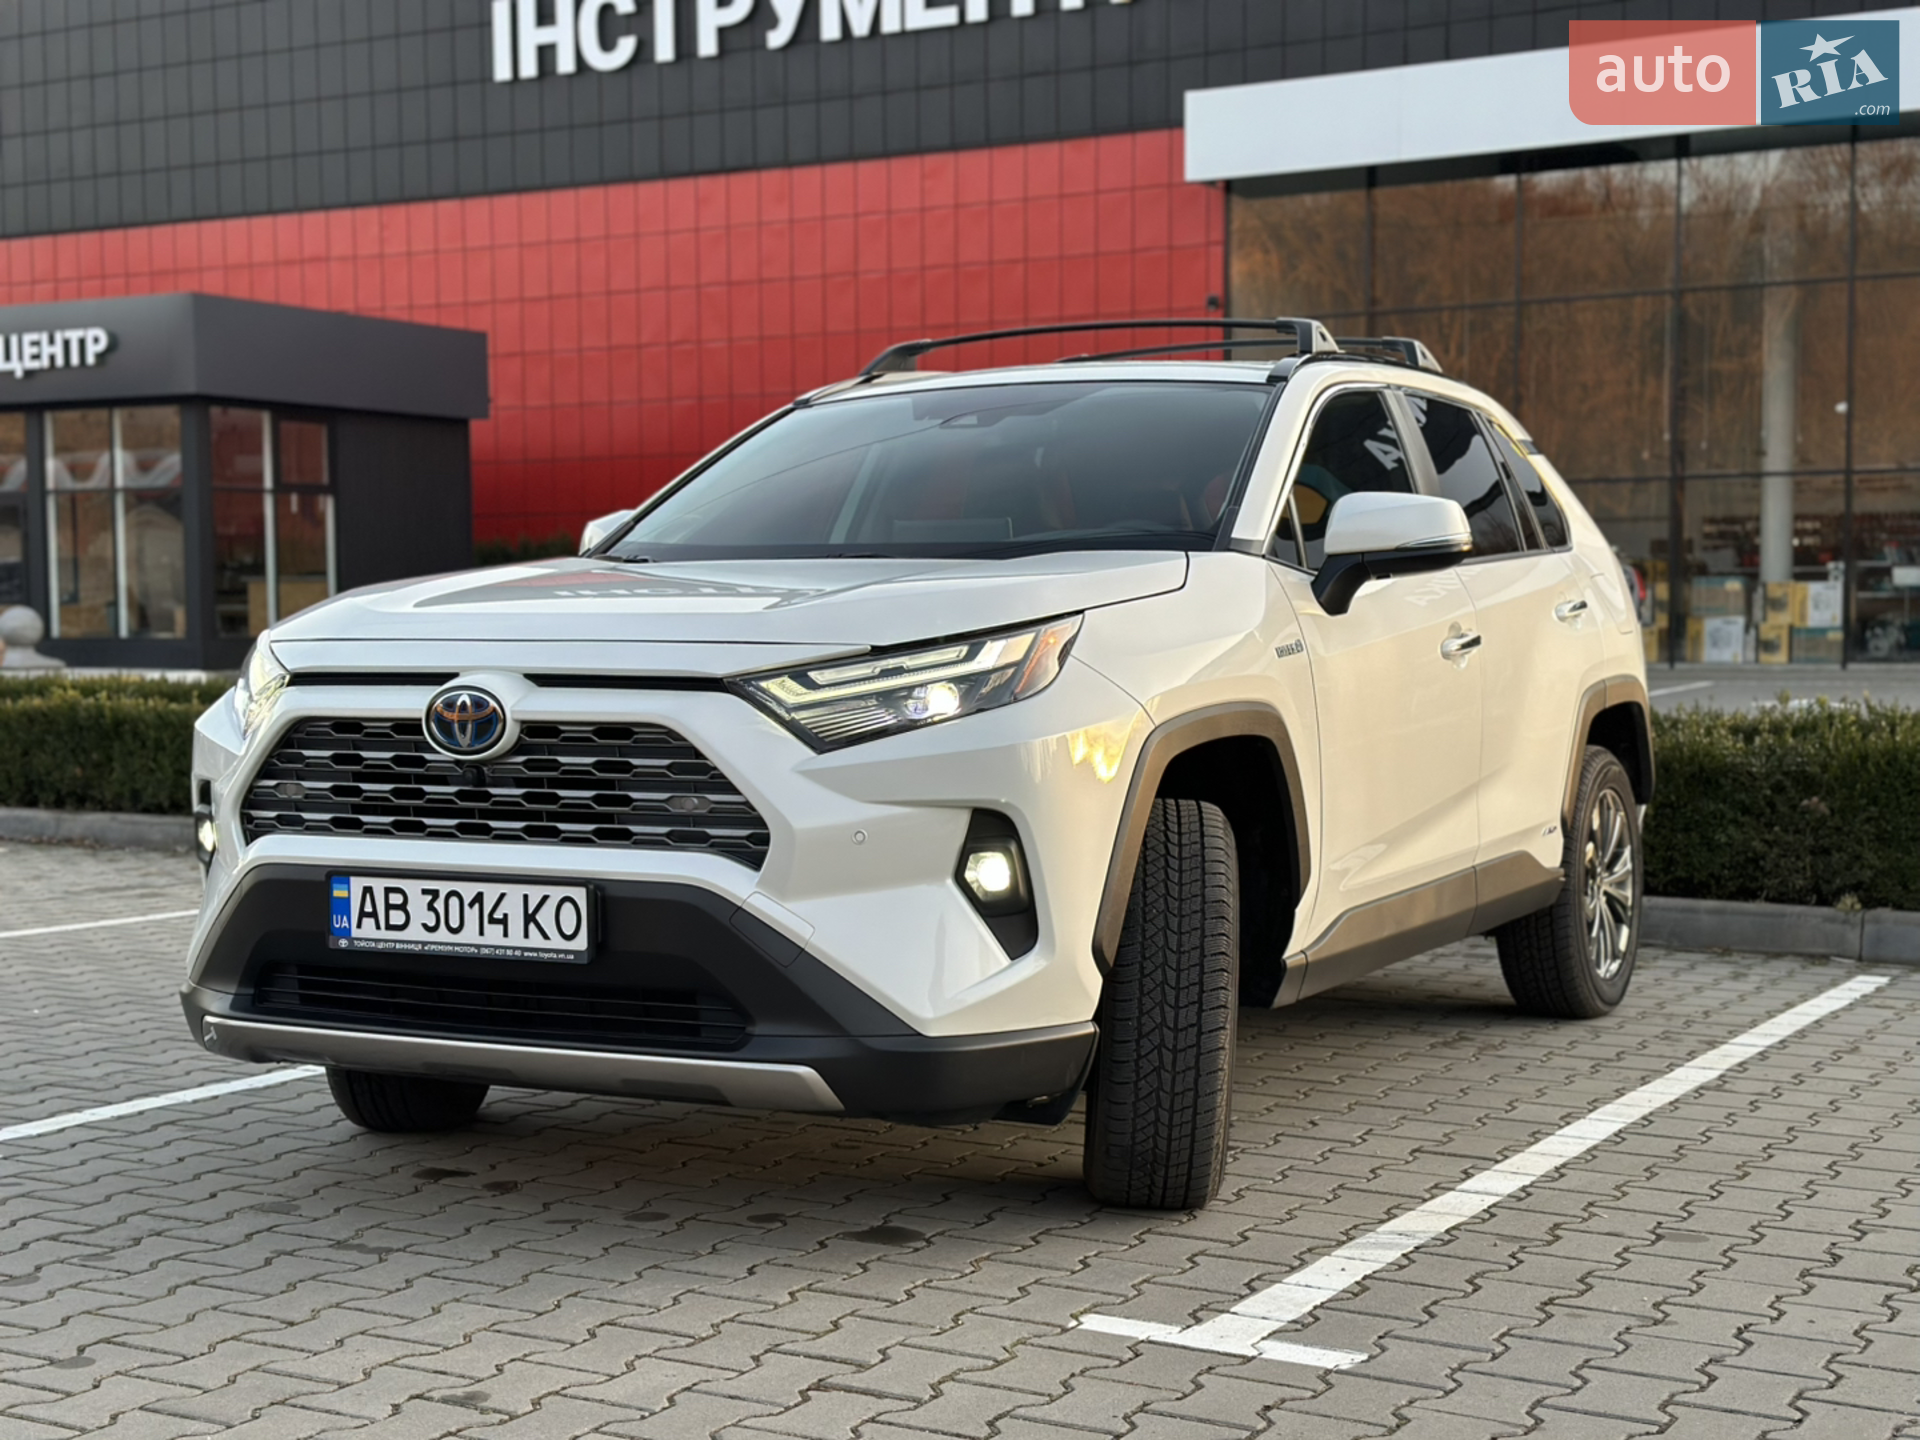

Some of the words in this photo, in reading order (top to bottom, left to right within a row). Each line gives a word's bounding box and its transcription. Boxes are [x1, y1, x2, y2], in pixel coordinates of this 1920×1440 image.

[491, 0, 1131, 82] ІНСТРУМ
[333, 914, 350, 929] UA
[355, 885, 411, 932] AB
[420, 888, 509, 938] 3014
